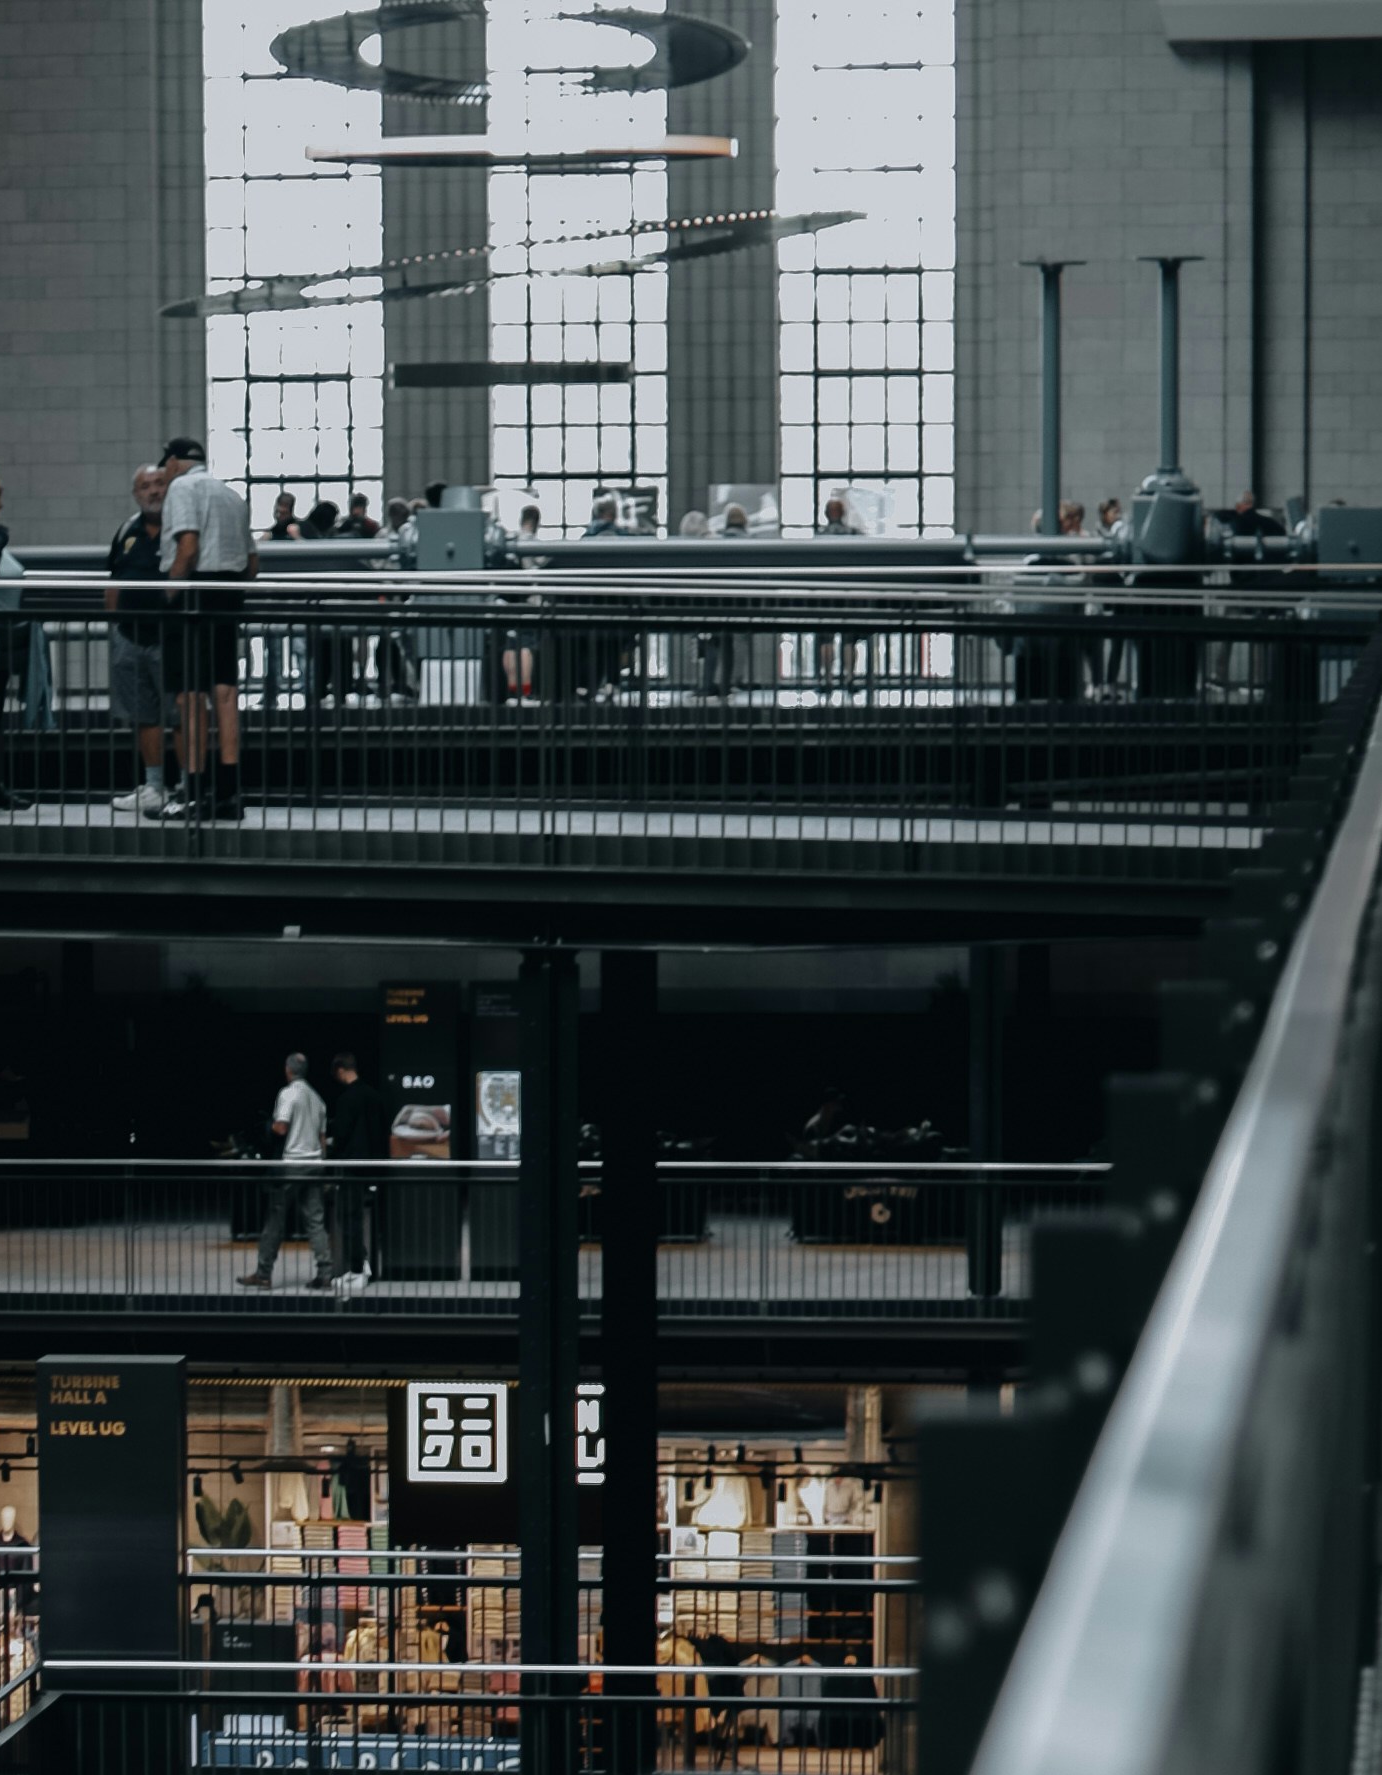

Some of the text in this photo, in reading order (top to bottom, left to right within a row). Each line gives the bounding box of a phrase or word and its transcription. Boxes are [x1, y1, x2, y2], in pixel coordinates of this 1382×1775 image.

[402, 1075, 435, 1088] BAO
[51, 1375, 121, 1389] TURBINE
[50, 1390, 107, 1405] HALL A
[50, 1420, 126, 1436] LEVEL UG
